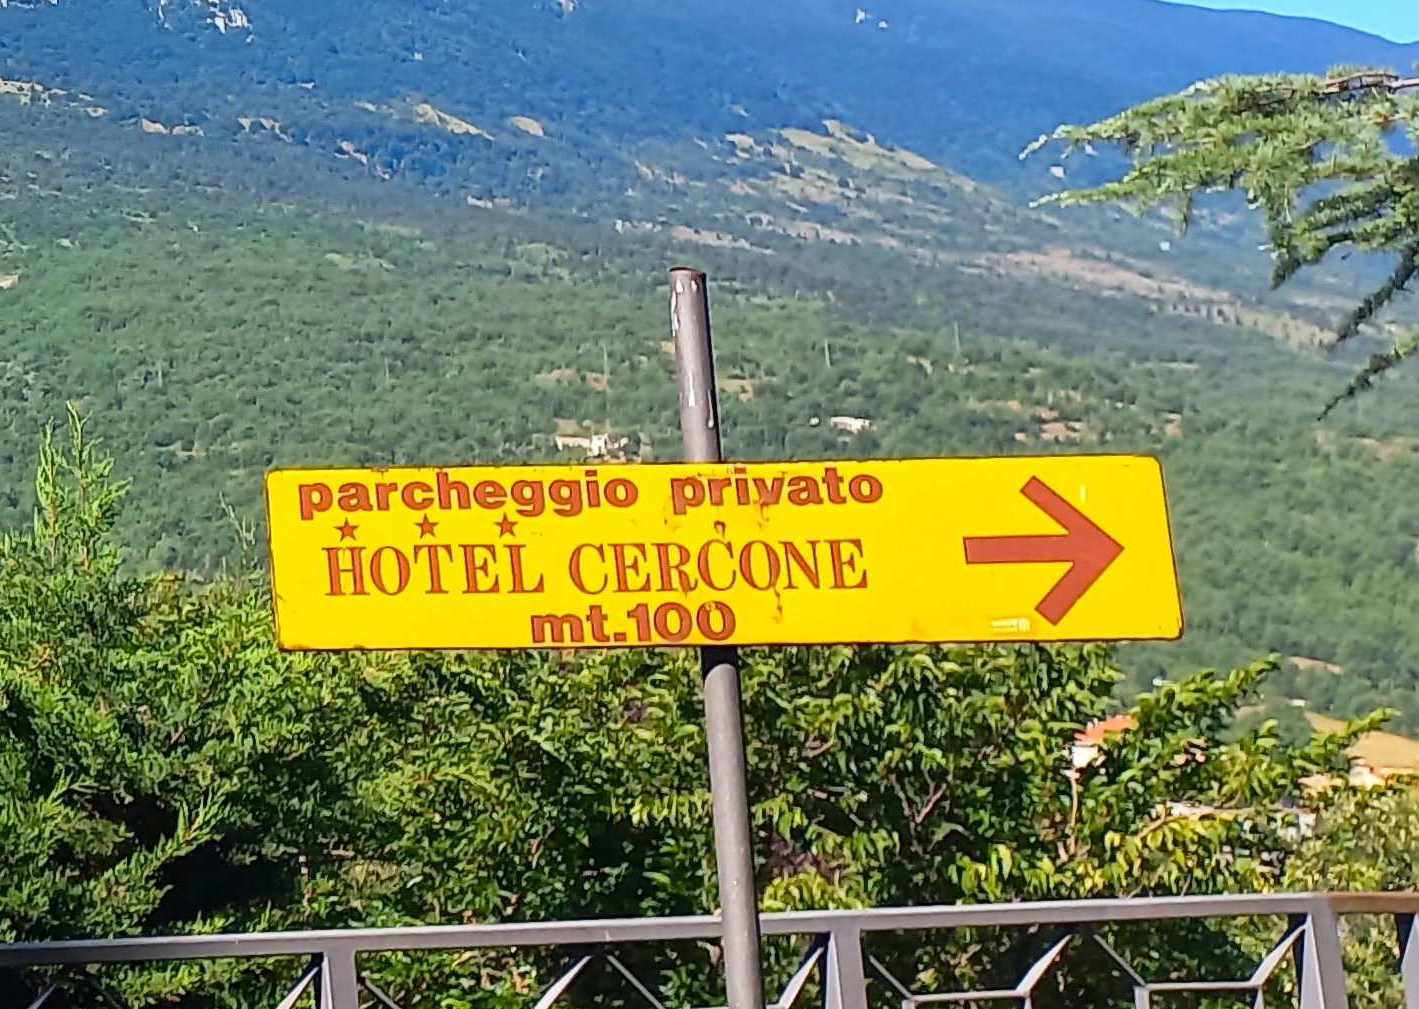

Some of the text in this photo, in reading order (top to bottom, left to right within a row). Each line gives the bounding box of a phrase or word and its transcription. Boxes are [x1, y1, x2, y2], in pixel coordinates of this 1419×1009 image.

[298, 466, 884, 521] parcheggio privato
[321, 538, 868, 596] HOTEL CERCONE
[530, 600, 737, 643] mt.100
